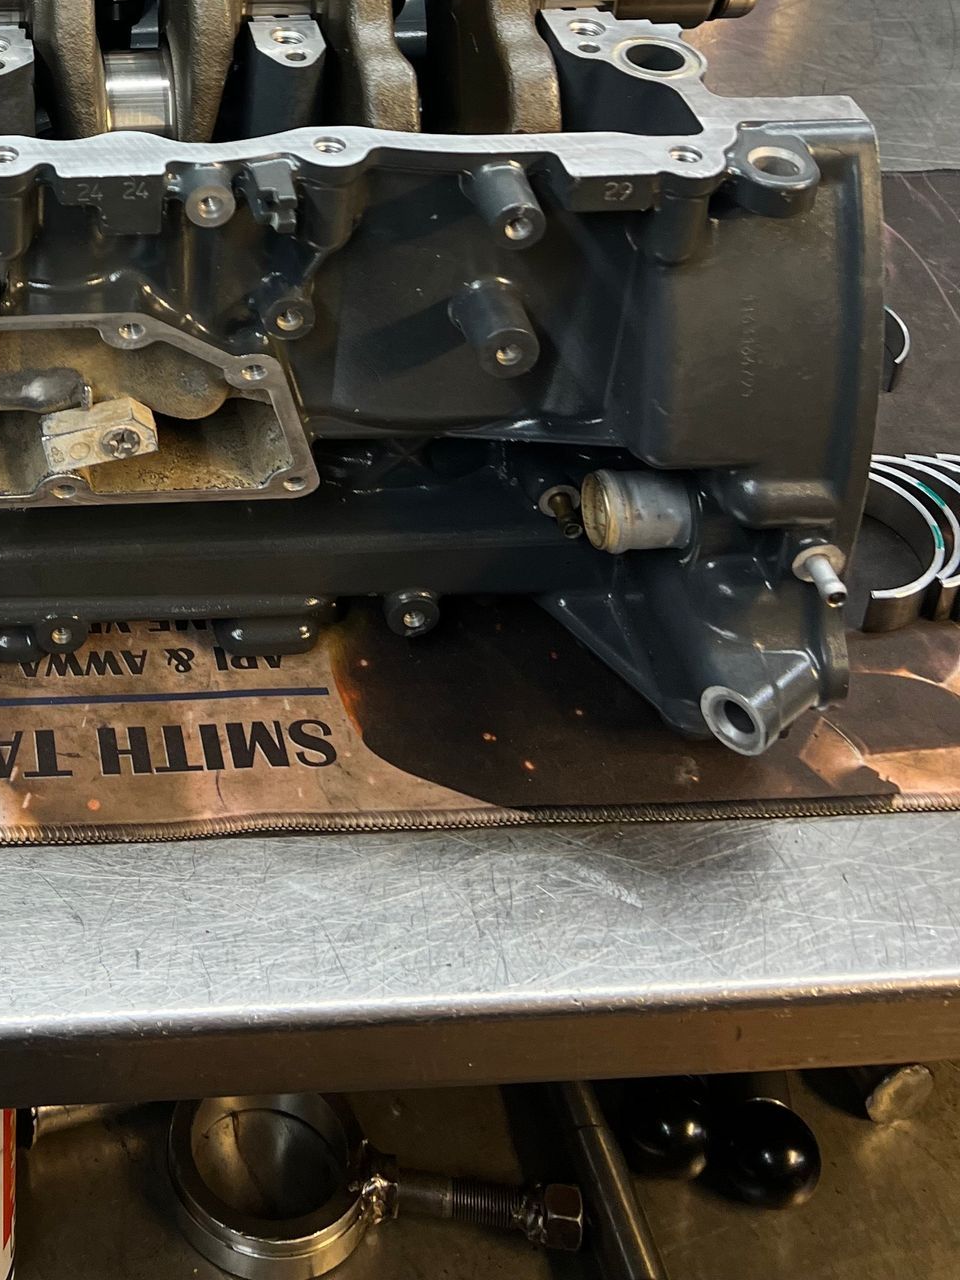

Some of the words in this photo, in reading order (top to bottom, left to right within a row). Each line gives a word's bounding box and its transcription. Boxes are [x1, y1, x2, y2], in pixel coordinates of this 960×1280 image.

[76, 183, 104, 202] 24
[122, 181, 150, 200] 24
[18, 646, 146, 679] AWWA
[166, 646, 197, 674] &
[97, 718, 338, 775] SMITH
